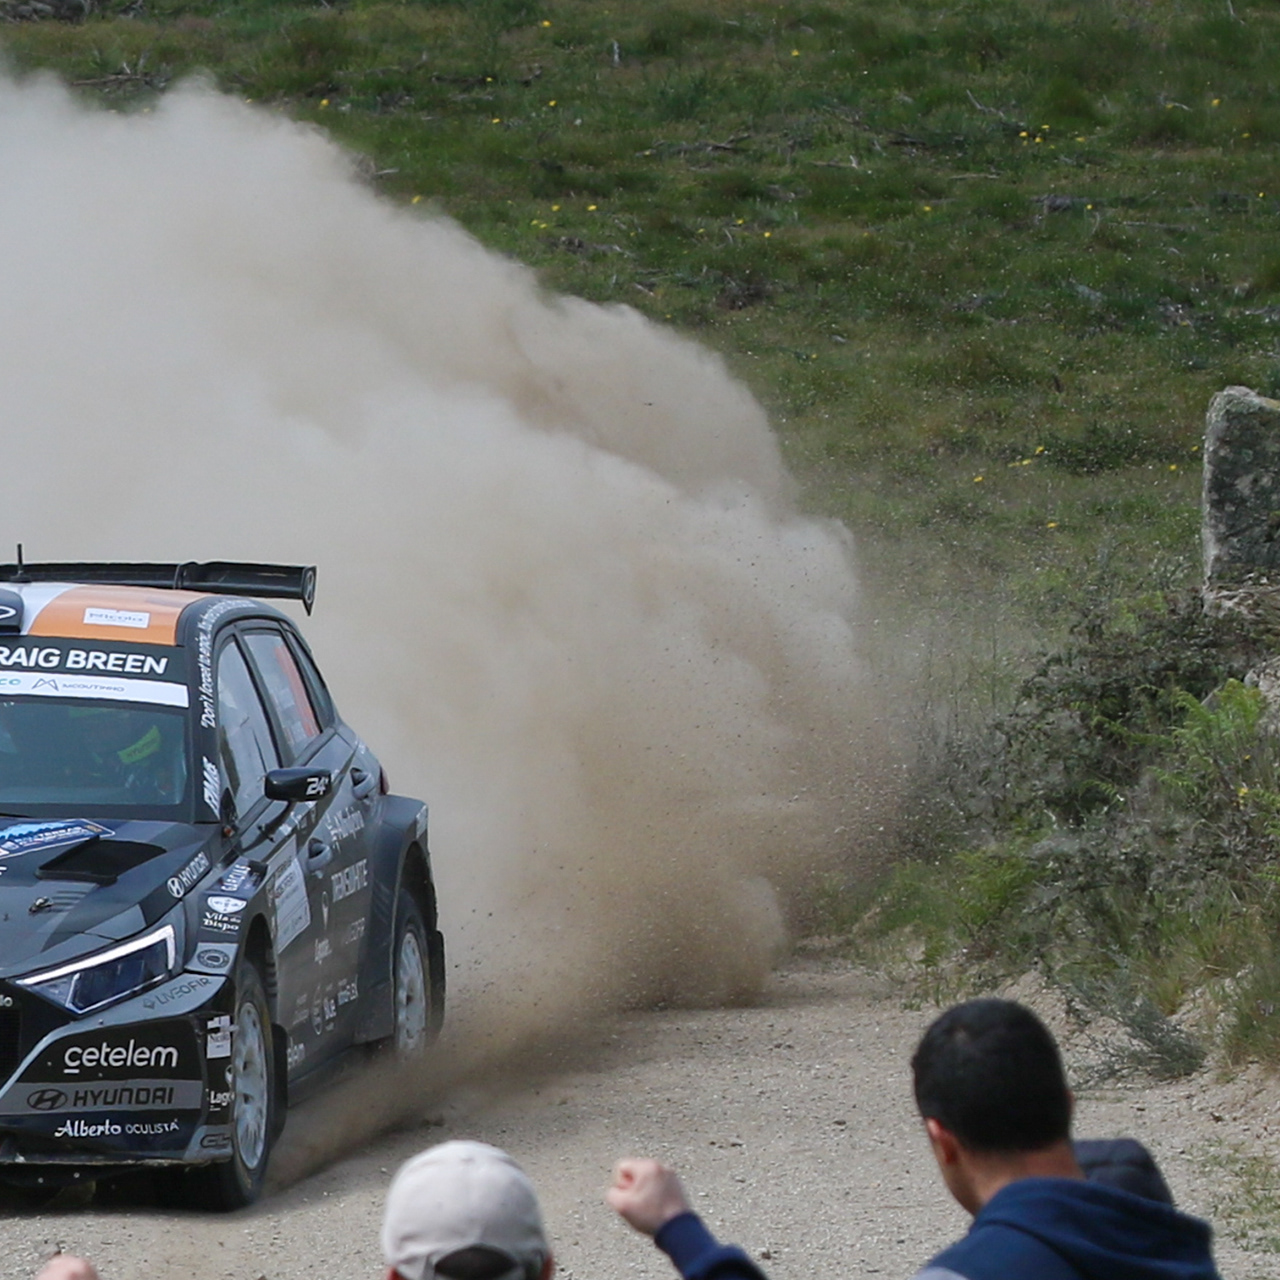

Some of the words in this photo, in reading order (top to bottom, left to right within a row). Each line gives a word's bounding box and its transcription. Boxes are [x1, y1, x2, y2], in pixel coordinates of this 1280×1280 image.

[66, 650, 168, 674] BREEN
[178, 851, 210, 889] HYUNDAI
[202, 918, 239, 931] Bispo
[204, 911, 229, 922] Vila
[155, 976, 212, 1006] LIVEOFIR
[63, 1039, 179, 1074] cetelem
[73, 1087, 174, 1107] HYUNDAI
[54, 1120, 121, 1138] Alberto
[125, 1119, 180, 1135] OCULISTA
